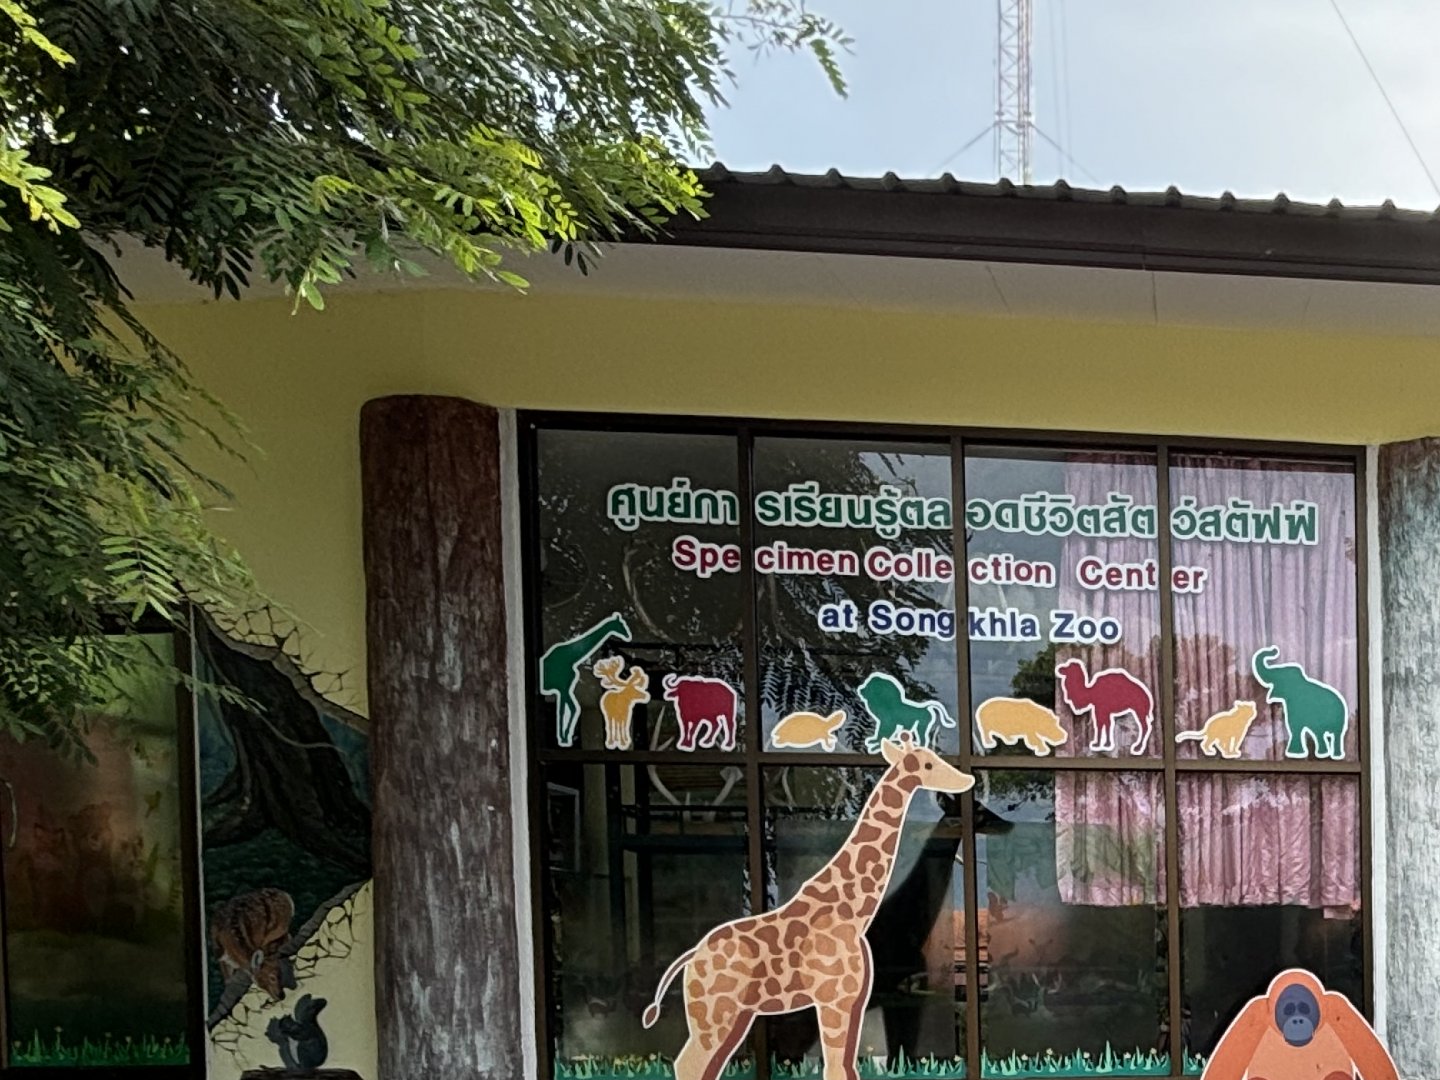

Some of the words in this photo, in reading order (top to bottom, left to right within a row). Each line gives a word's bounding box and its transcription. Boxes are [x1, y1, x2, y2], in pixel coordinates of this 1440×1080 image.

[673, 537, 856, 575] Specimen
[867, 549, 1052, 584] Collection
[1079, 560, 1205, 590] Center
[821, 603, 854, 629] at
[872, 603, 1038, 637] Songkhla
[1053, 612, 1120, 640] Zoo
